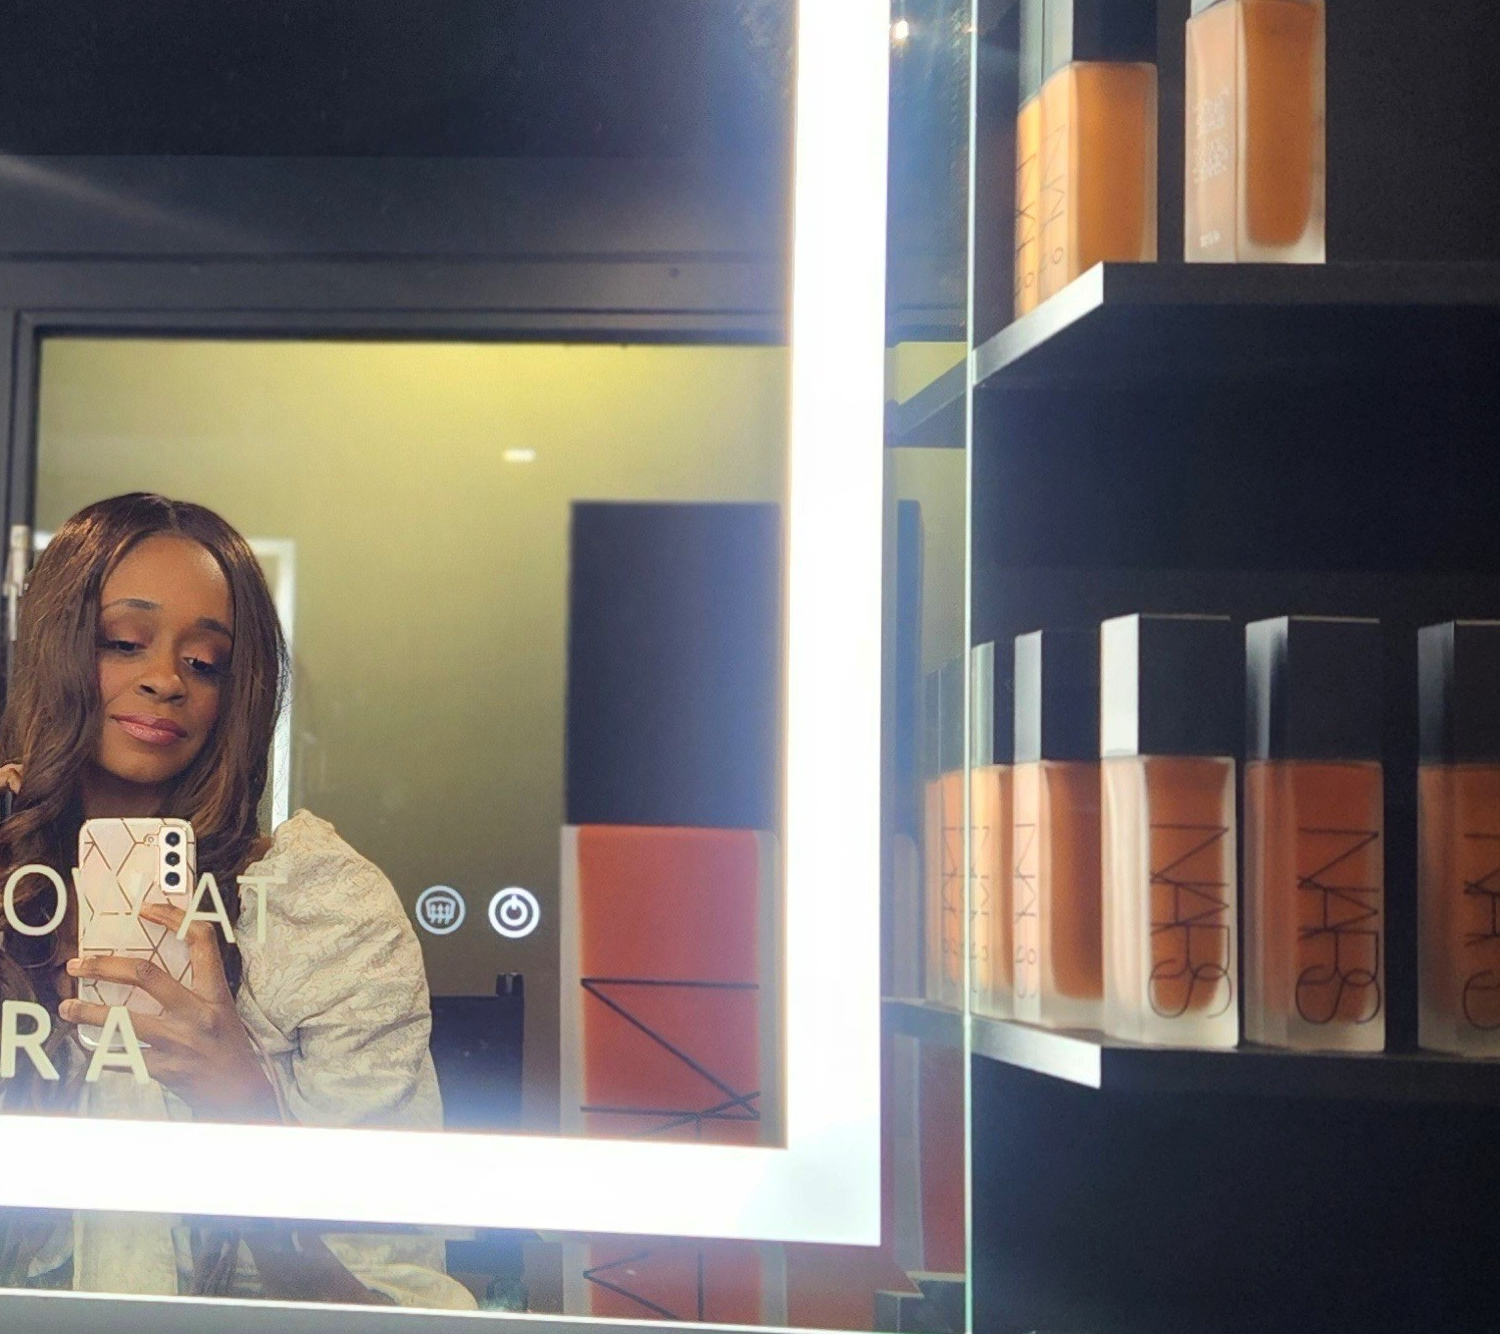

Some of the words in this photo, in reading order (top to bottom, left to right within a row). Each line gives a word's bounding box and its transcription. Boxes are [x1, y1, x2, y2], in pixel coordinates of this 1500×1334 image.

[176, 871, 289, 945] AT
[1148, 823, 1232, 1020] NARS
[1295, 827, 1382, 1025] NARS
